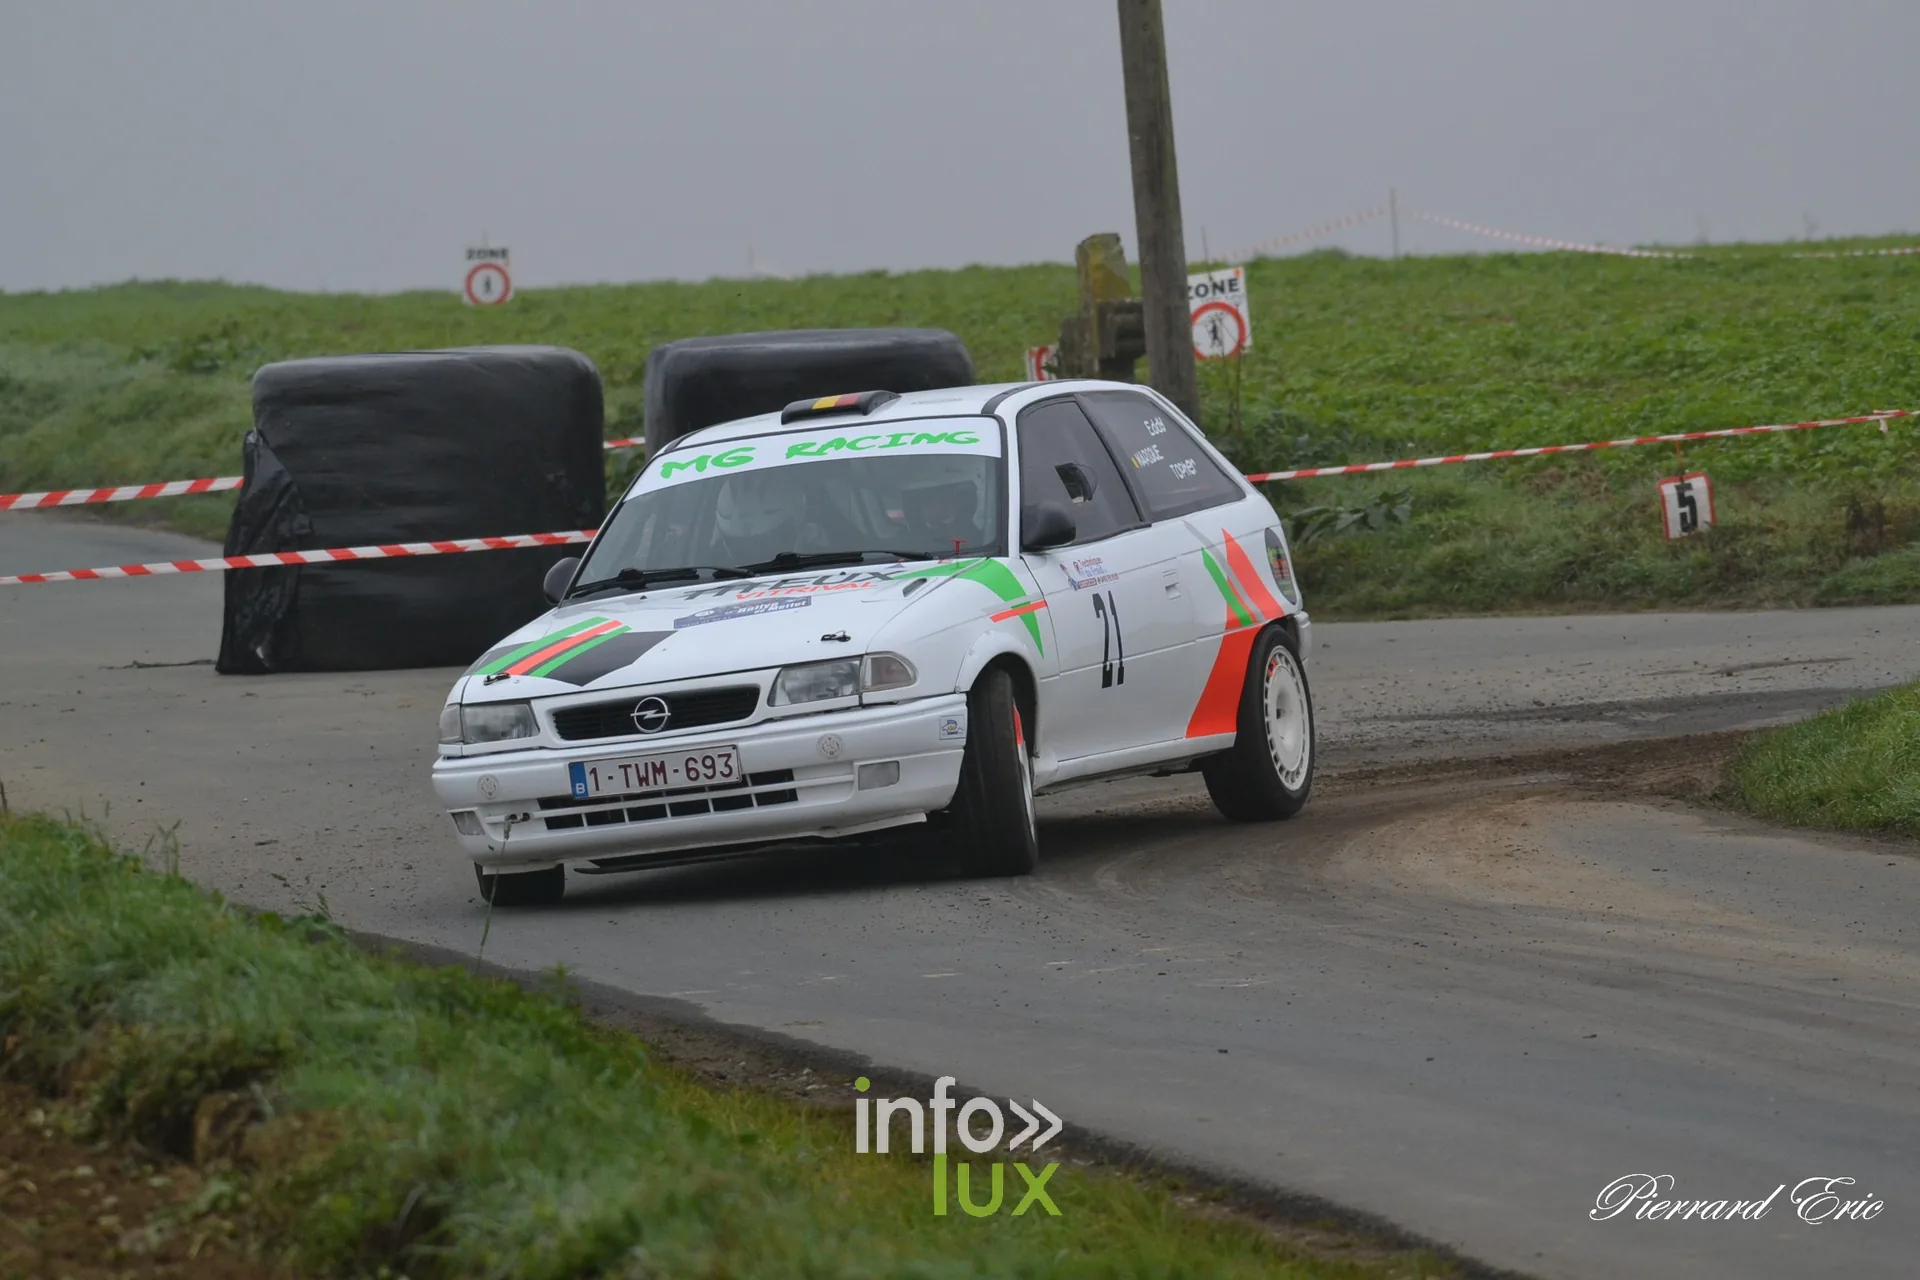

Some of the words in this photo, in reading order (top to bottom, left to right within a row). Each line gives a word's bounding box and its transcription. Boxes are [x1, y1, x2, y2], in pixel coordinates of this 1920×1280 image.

[660, 447, 756, 479] MG
[786, 431, 980, 459] RACING
[1674, 482, 1698, 535] 5
[736, 581, 878, 600] VITRIVAL
[737, 602, 779, 613] Rallye
[767, 600, 807, 612] Mettet
[1092, 590, 1125, 689] 21
[589, 752, 734, 792] 1-TWM-693
[575, 782, 586, 795] B
